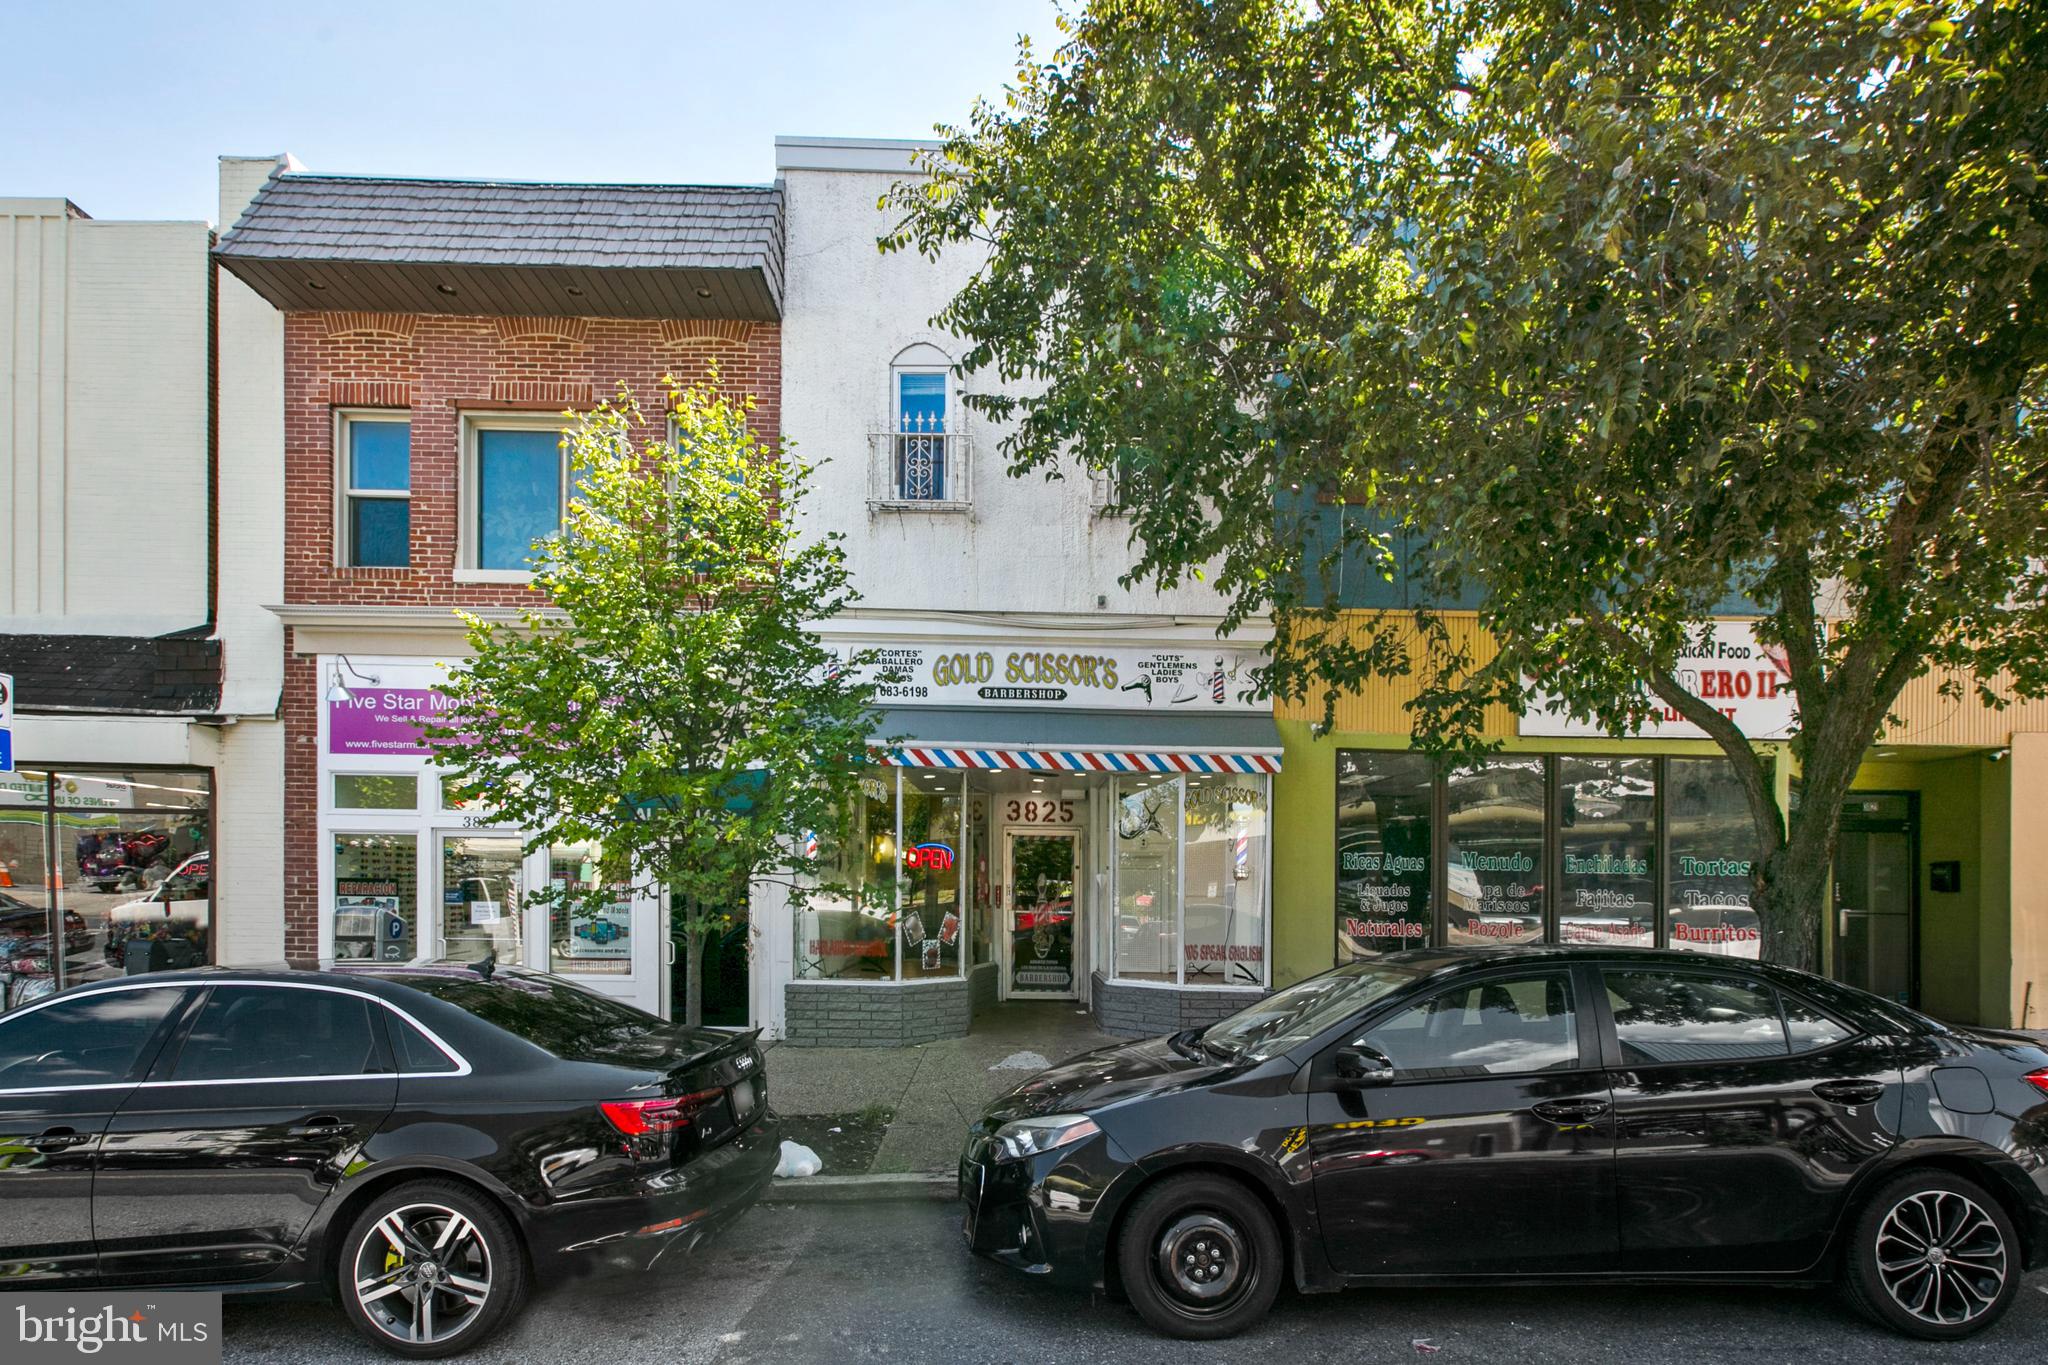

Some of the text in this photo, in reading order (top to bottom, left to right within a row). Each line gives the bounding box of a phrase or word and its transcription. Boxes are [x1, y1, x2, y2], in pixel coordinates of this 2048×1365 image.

[874, 658, 923, 666] ABALLERO
[1137, 661, 1198, 669] GENTLEMENS
[1152, 654, 1184, 662] "CUTS"
[882, 665, 914, 673] DAMAS
[932, 652, 1119, 689] GOLD SCISSOR'S
[383, 693, 424, 710] Star
[984, 688, 1062, 700] BARBERSHOP
[374, 715, 390, 723] We
[391, 715, 408, 723] Sell
[419, 715, 446, 724] Repair
[1006, 800, 1074, 823] 3825
[906, 847, 952, 871] OPEN
[1343, 852, 1425, 876] Ricas Aguas
[1461, 851, 1533, 872] Menudo
[1565, 854, 1648, 875] Enchiladas
[1680, 856, 1751, 876] Tortas
[1507, 882, 1526, 897] de
[1684, 889, 1750, 908] Tacos
[1360, 897, 1409, 915] & Jugos
[1464, 897, 1530, 912] Mariscos
[1576, 889, 1635, 912] Fajitas
[1346, 918, 1422, 938] Naturales
[1468, 918, 1525, 938] Pozole
[1675, 922, 1758, 942] Burritos
[1228, 945, 1263, 962] ENGLISH
[1020, 973, 1067, 983] BARBERSHOP
